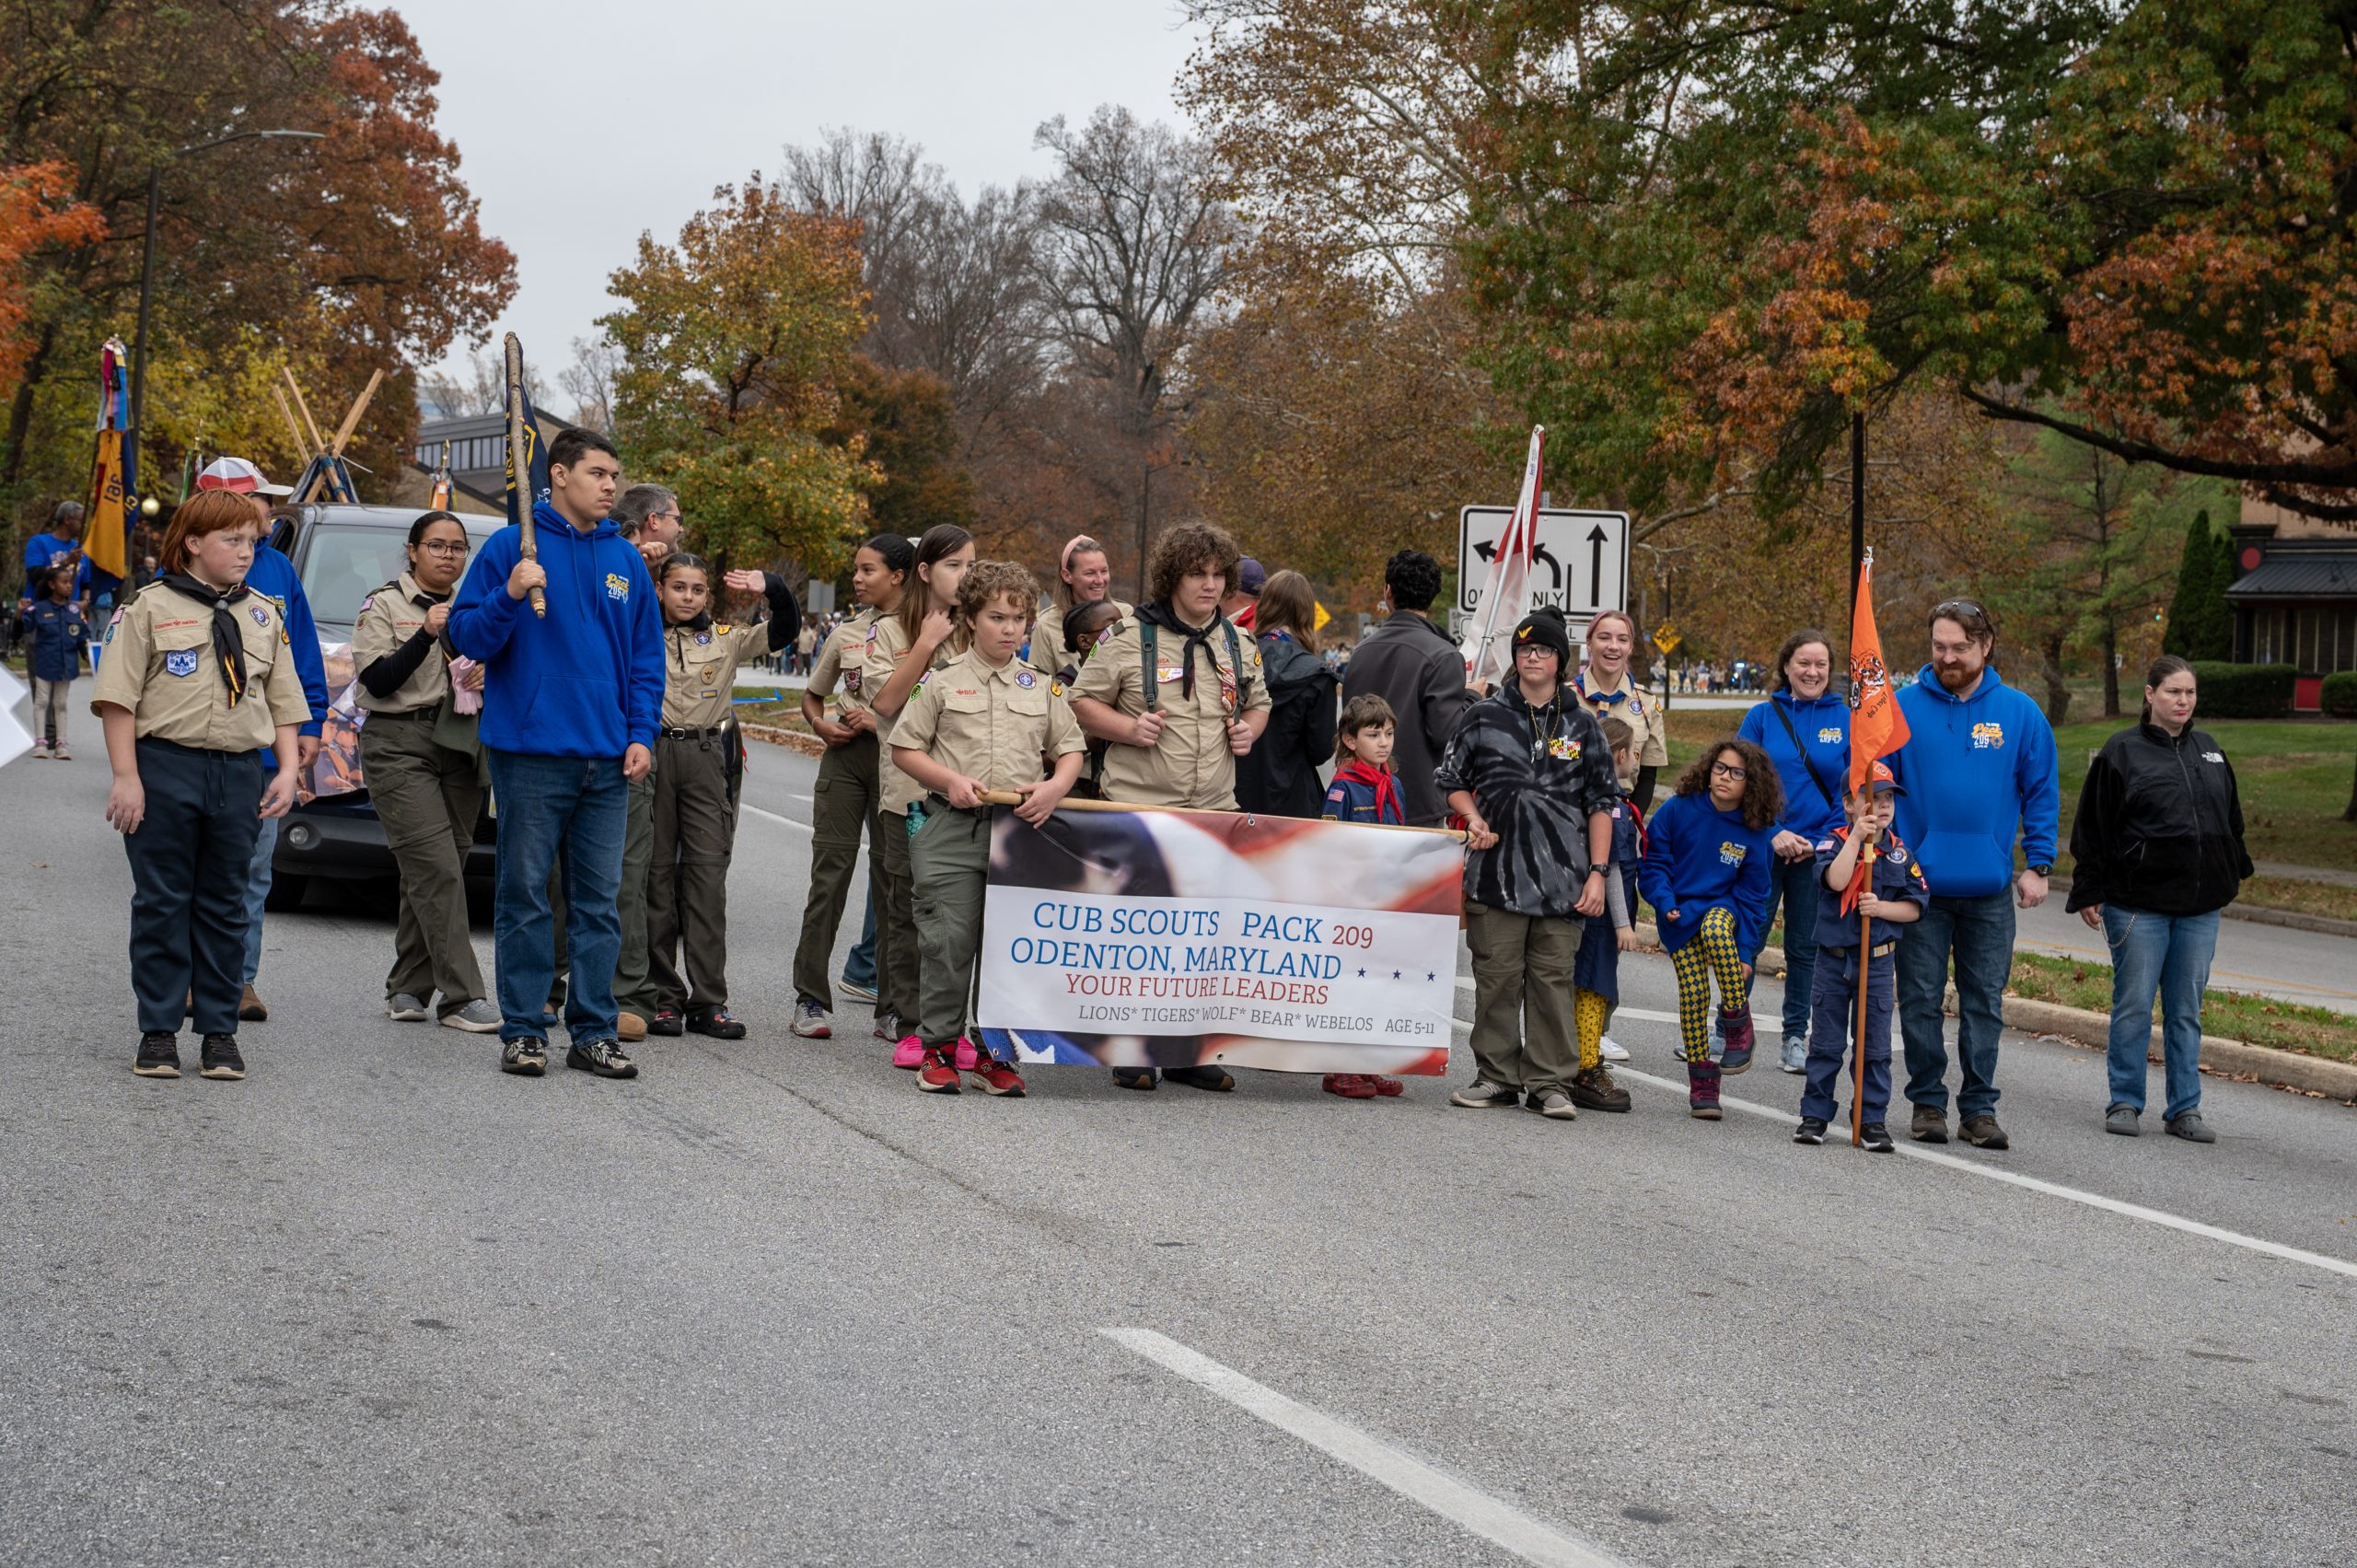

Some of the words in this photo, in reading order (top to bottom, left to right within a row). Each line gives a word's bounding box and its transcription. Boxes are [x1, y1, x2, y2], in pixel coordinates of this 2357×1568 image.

[1971, 723, 2003, 738] Pack
[1034, 902, 1102, 933] CUB
[1110, 908, 1220, 935] SCOUTS
[1240, 911, 1323, 943] PACK
[1331, 924, 1374, 949] 209
[1011, 937, 1177, 974] ODENTON,
[1183, 946, 1342, 980] MARYLAND
[1065, 973, 1132, 997] YOUR
[1138, 977, 1218, 998] FUTURE
[1222, 977, 1329, 1005] LEADERS
[1306, 1014, 1374, 1031] WEBELOS
[1385, 1018, 1411, 1033] AGE
[1414, 1021, 1435, 1035] 5-11
